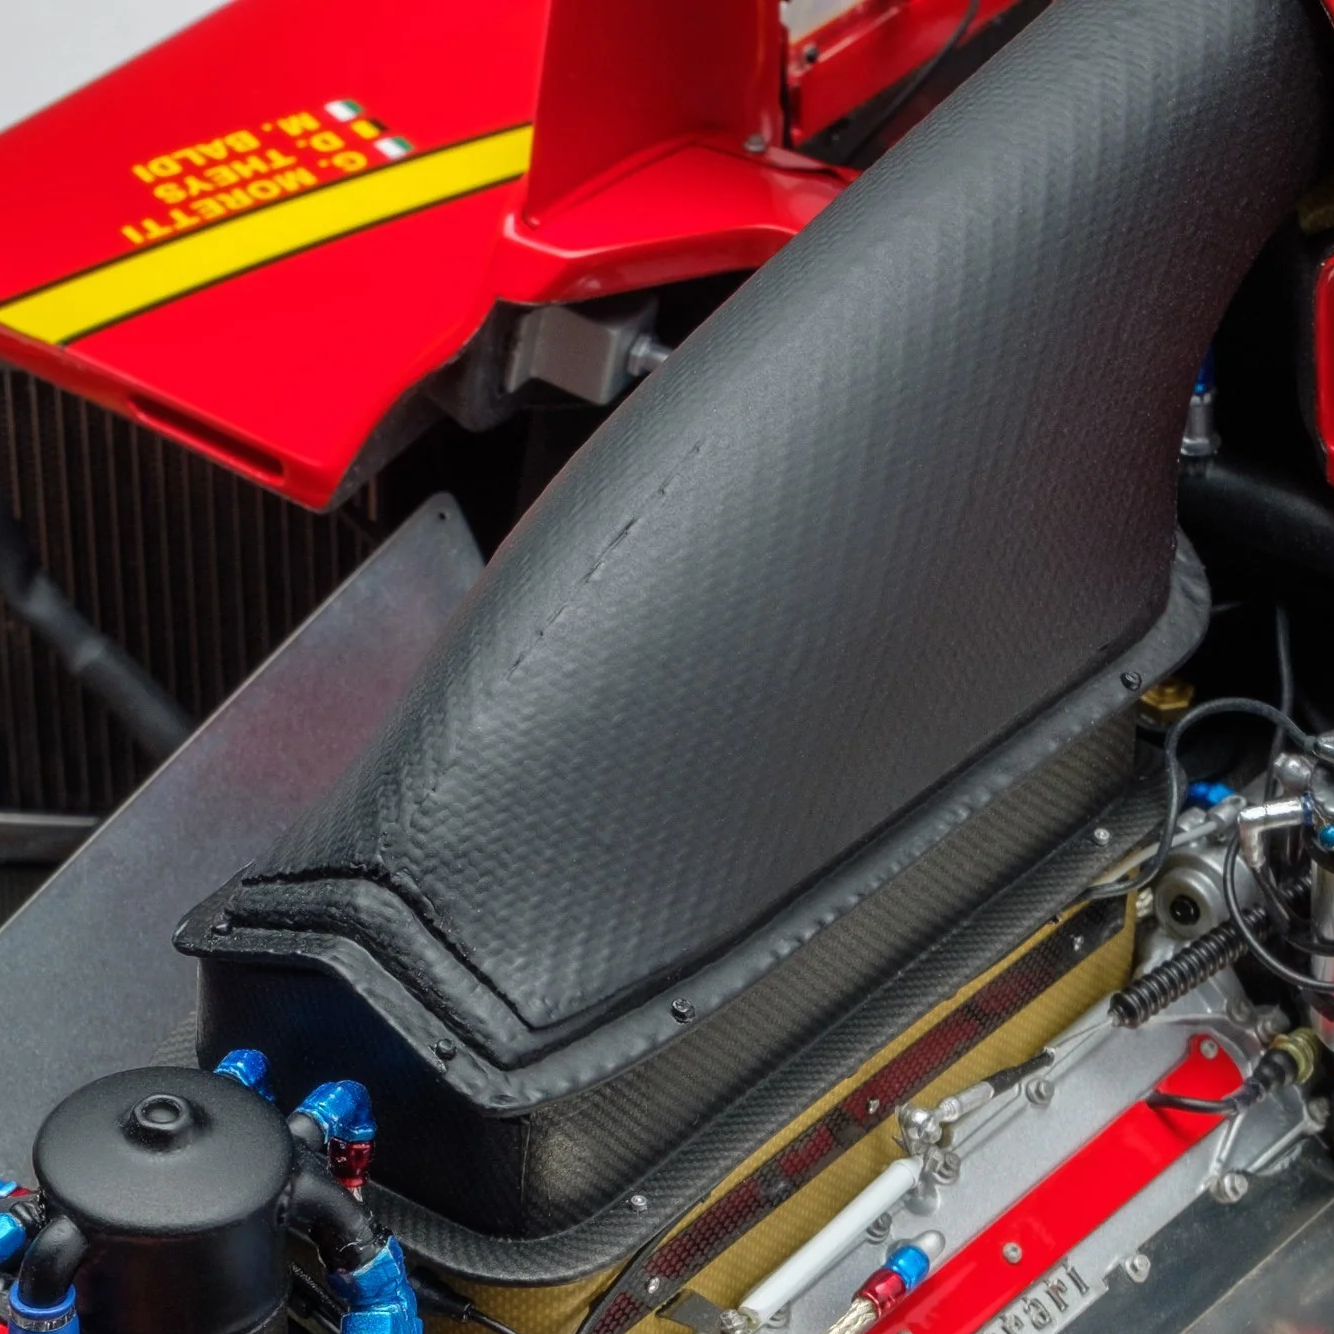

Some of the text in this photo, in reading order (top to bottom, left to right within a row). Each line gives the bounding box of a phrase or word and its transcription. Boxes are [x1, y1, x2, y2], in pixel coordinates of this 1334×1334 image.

[131, 111, 321, 184] M. BALDI
[152, 130, 345, 205] D. THEYS
[120, 150, 368, 246] G. MORETTI
